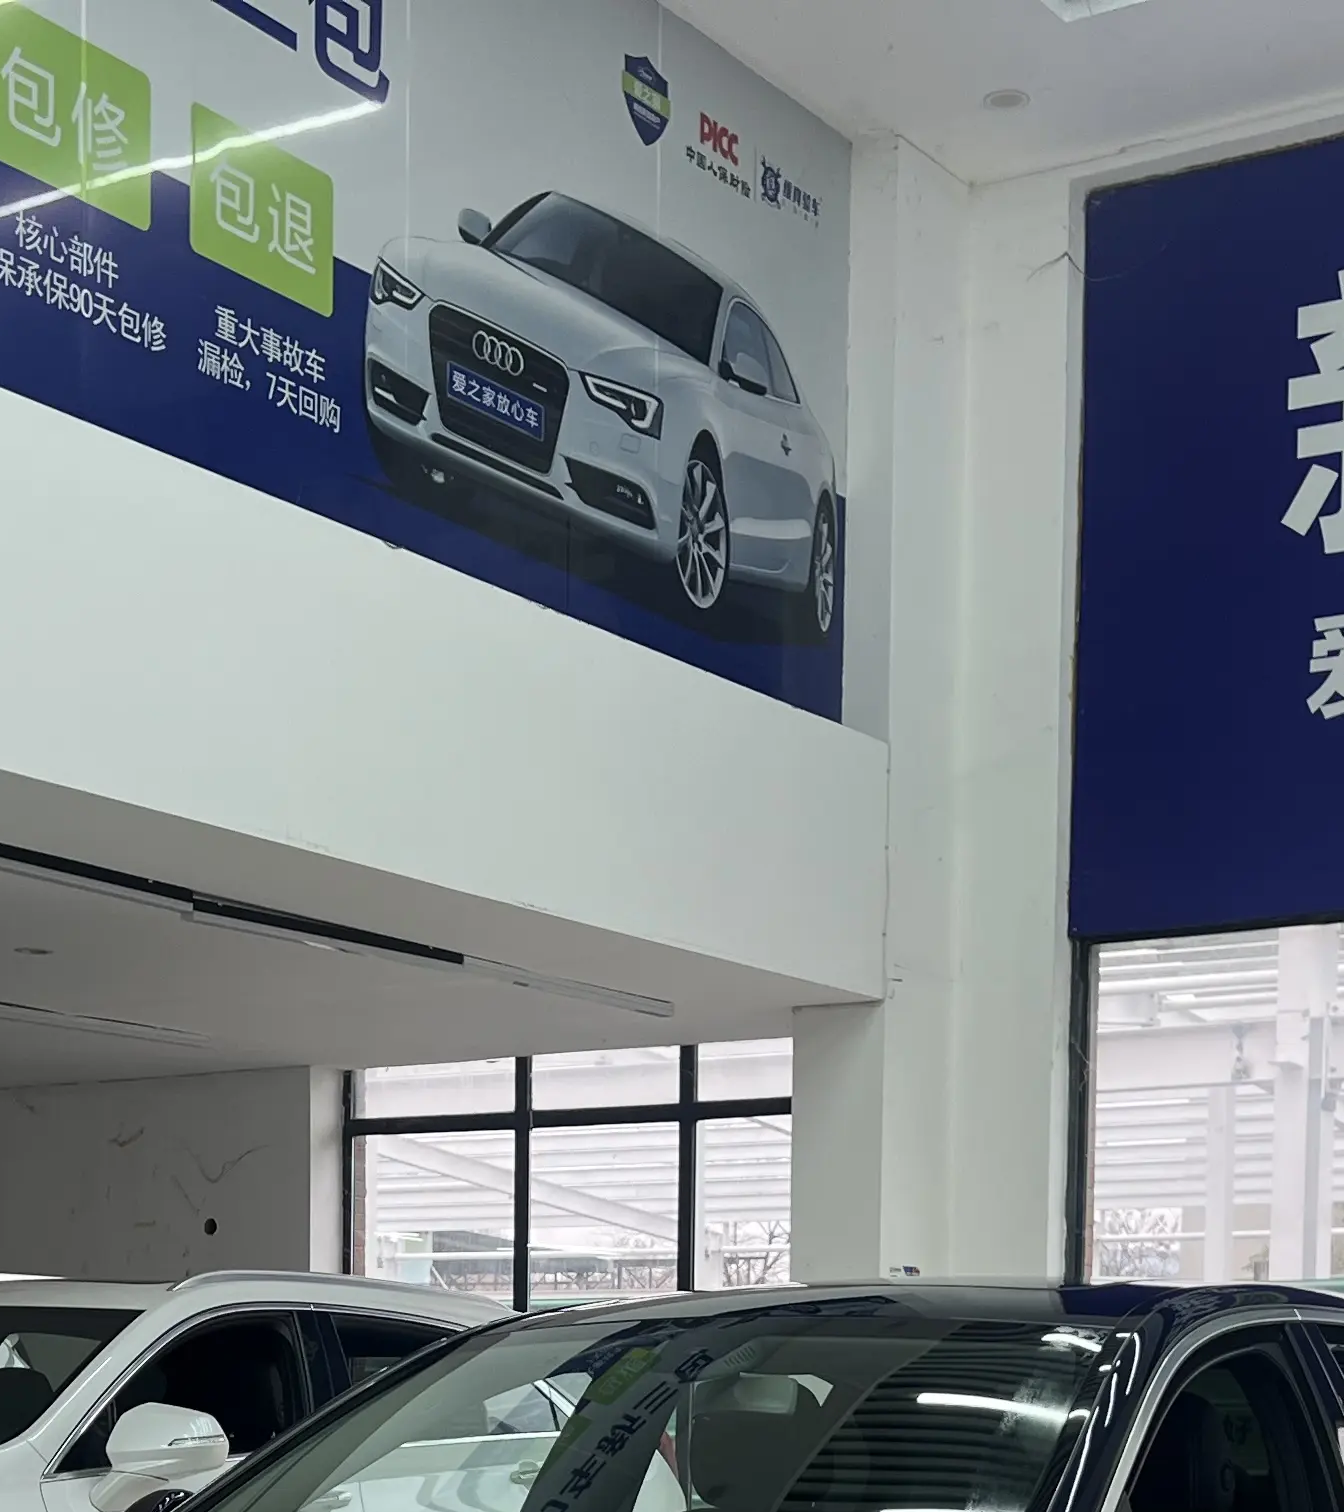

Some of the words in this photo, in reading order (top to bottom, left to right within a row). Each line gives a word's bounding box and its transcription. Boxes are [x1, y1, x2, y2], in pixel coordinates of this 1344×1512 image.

[1, 46, 128, 173] 包修
[699, 112, 739, 166] PICC
[15, 211, 120, 288] 核心部件
[209, 158, 317, 275] 包退
[214, 305, 326, 383] 重大事故车
[452, 370, 539, 428] 爱之家放心车
